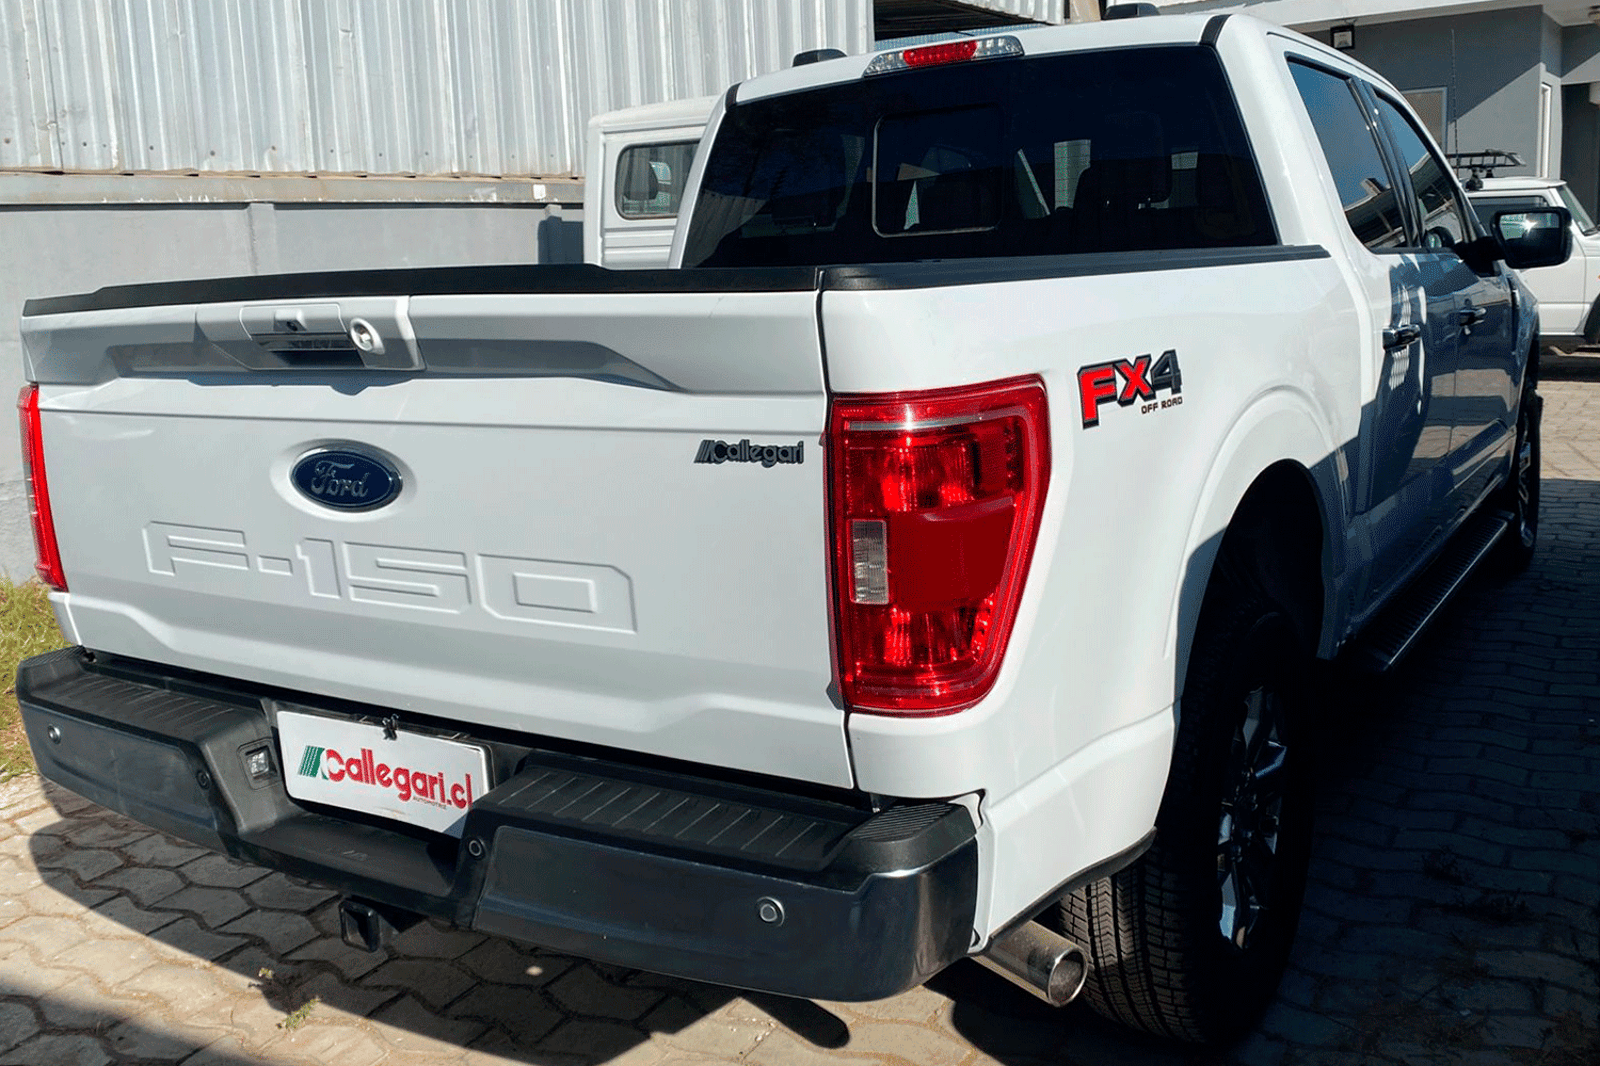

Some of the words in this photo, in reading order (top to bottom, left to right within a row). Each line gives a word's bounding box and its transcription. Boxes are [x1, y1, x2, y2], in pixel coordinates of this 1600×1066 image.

[1077, 348, 1182, 430] FX4
[1141, 402, 1159, 415] OFF
[1161, 396, 1183, 410] ROAD
[711, 439, 804, 468] Callegari
[310, 460, 370, 498] Ford
[142, 521, 638, 635] F-150
[321, 748, 474, 809] Callegari.cl
